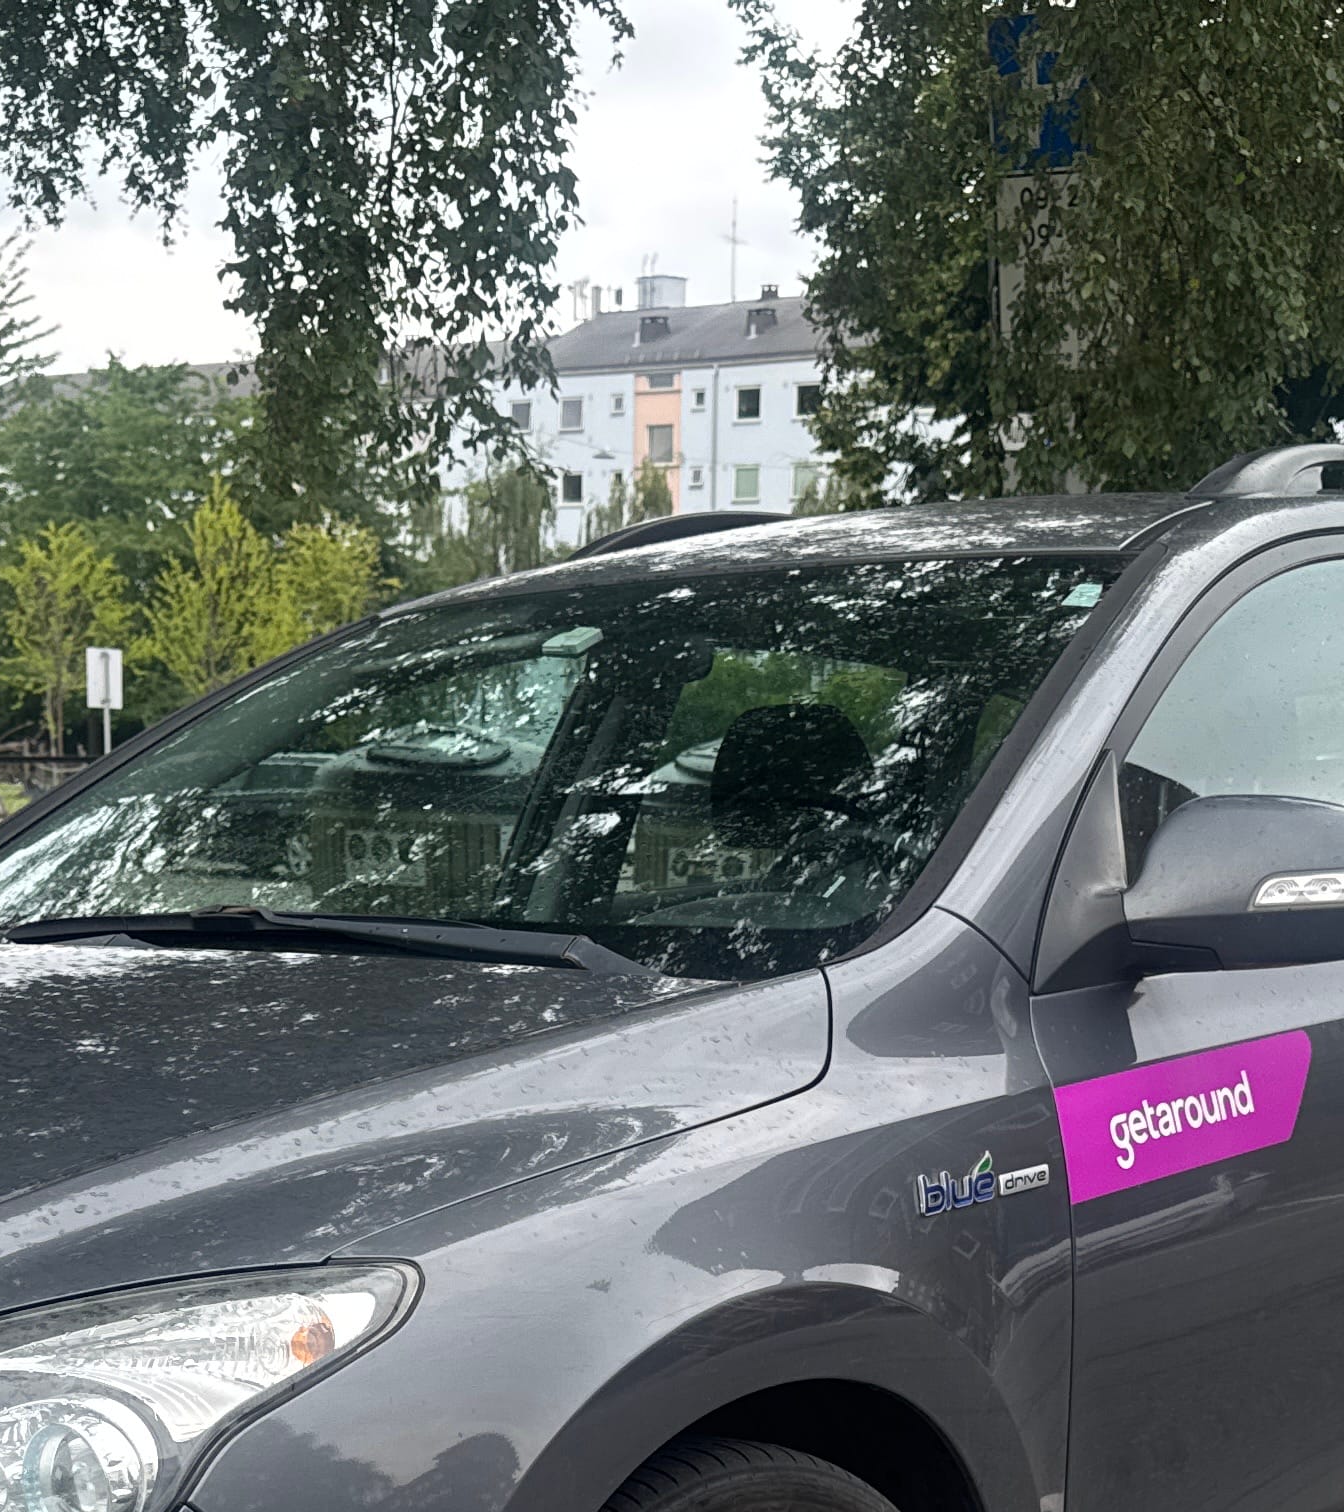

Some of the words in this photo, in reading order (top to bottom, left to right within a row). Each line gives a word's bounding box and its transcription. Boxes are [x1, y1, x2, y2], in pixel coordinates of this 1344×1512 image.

[1109, 1070, 1254, 1170] getaround
[918, 1166, 995, 1216] blue
[1004, 1170, 1047, 1191] drive
